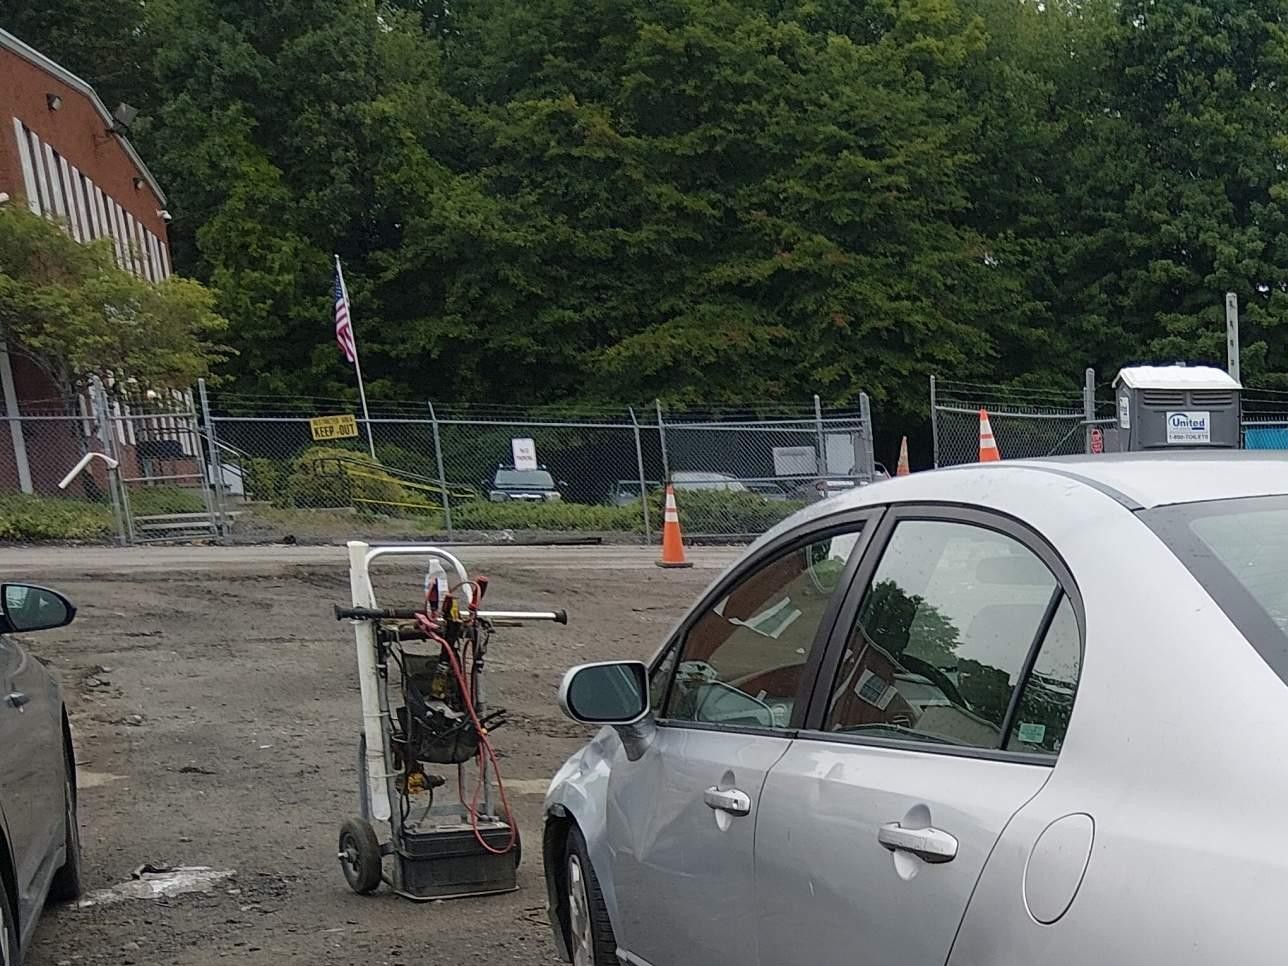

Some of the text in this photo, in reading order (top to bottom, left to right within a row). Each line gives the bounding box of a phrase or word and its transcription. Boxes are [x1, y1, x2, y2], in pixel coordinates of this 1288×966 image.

[1172, 418, 1205, 427] United
[314, 424, 355, 438] KEEP OUT
